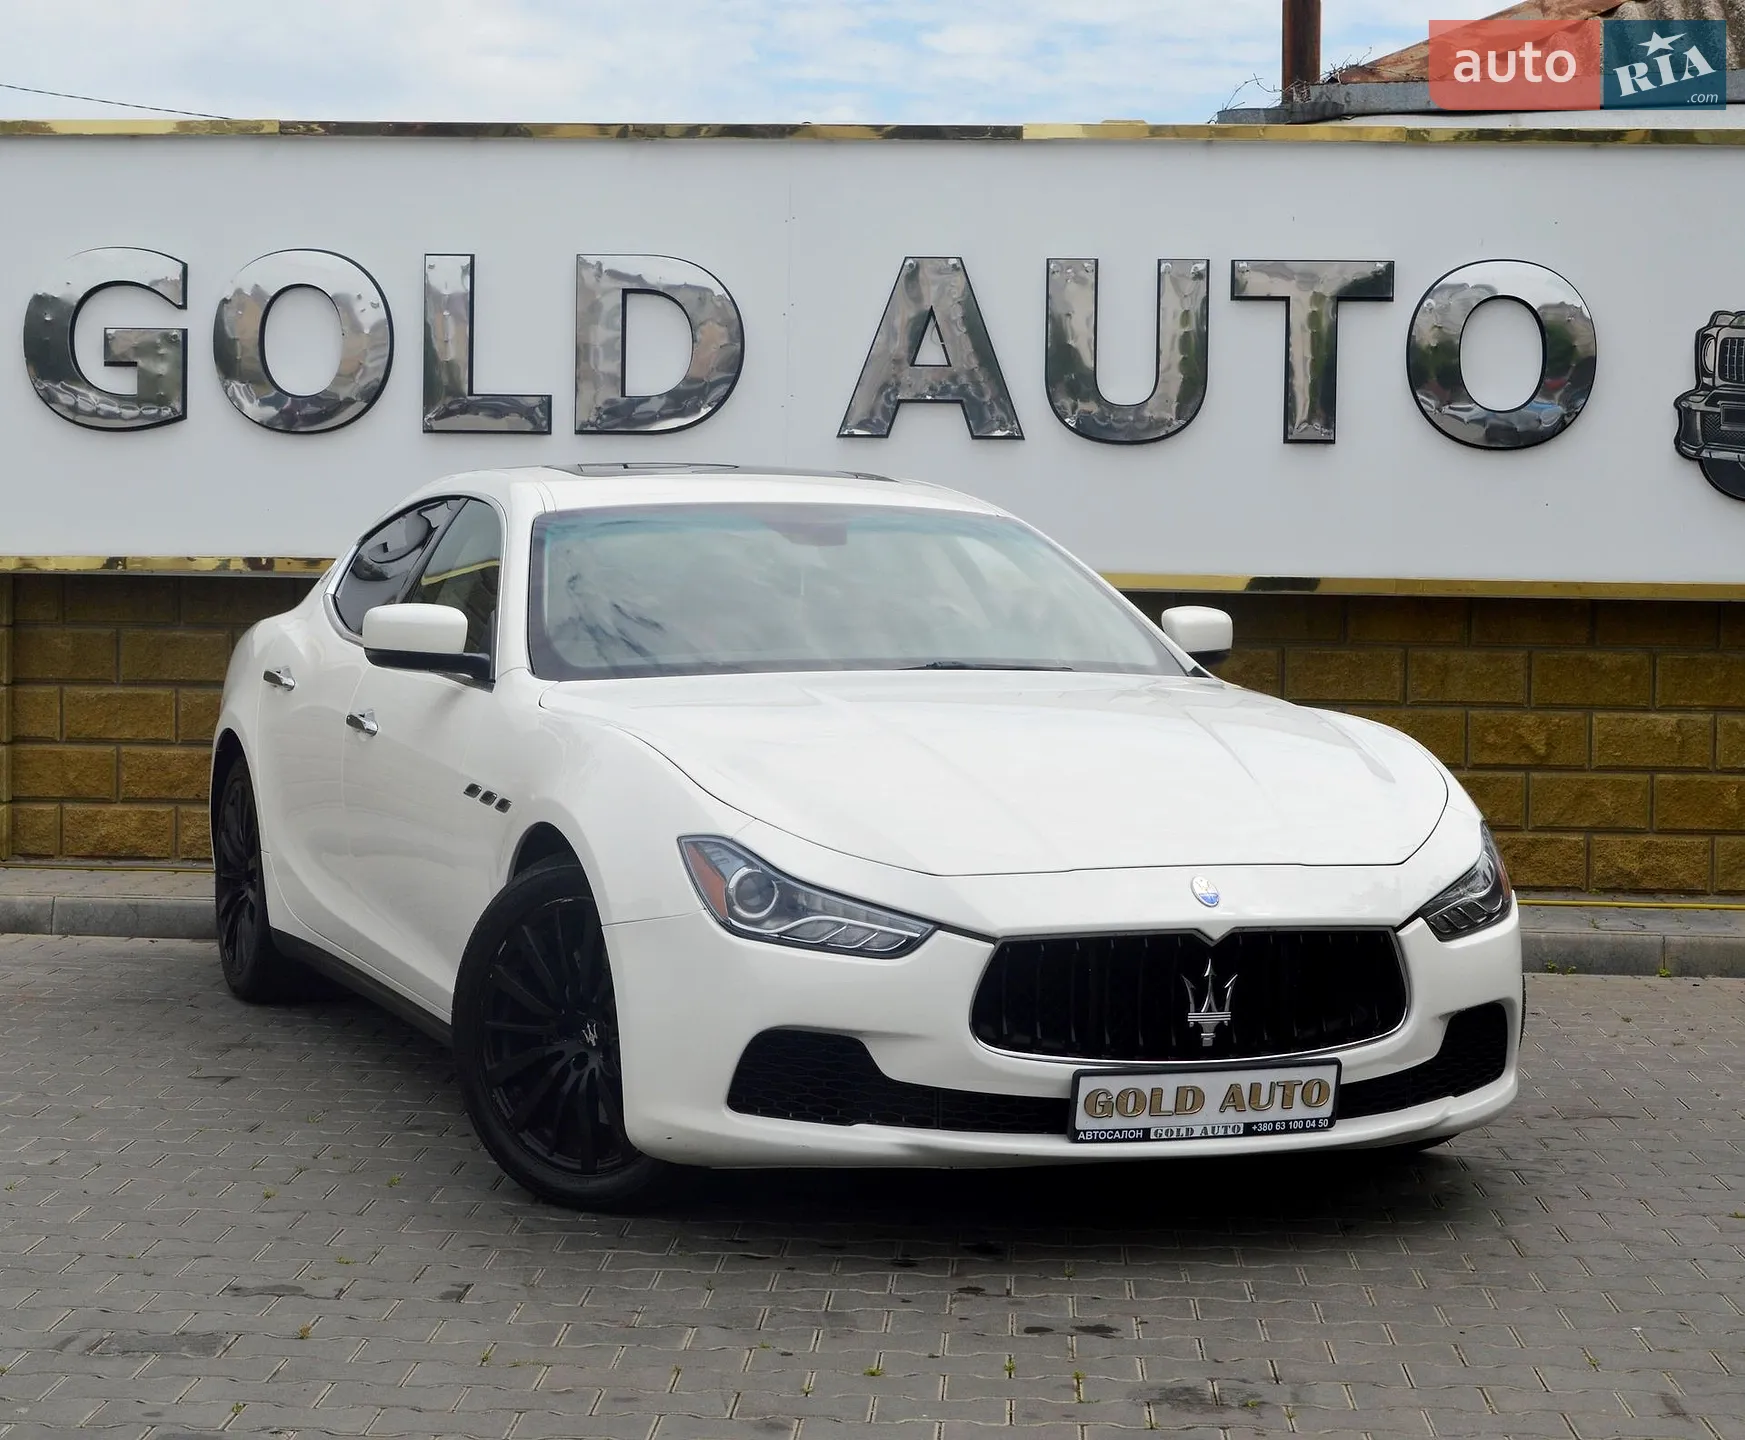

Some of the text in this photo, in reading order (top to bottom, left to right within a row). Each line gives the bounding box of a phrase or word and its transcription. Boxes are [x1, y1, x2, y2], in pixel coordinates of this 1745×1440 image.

[23, 246, 1597, 451] GOLD AUTO
[1084, 1078, 1331, 1118] GOLD AUTO
[1153, 1124, 1242, 1138] GOLD AUTO
[1251, 1118, 1329, 1132] +380 63 100 04 50
[1078, 1129, 1144, 1141] АВТОСАЛОН
